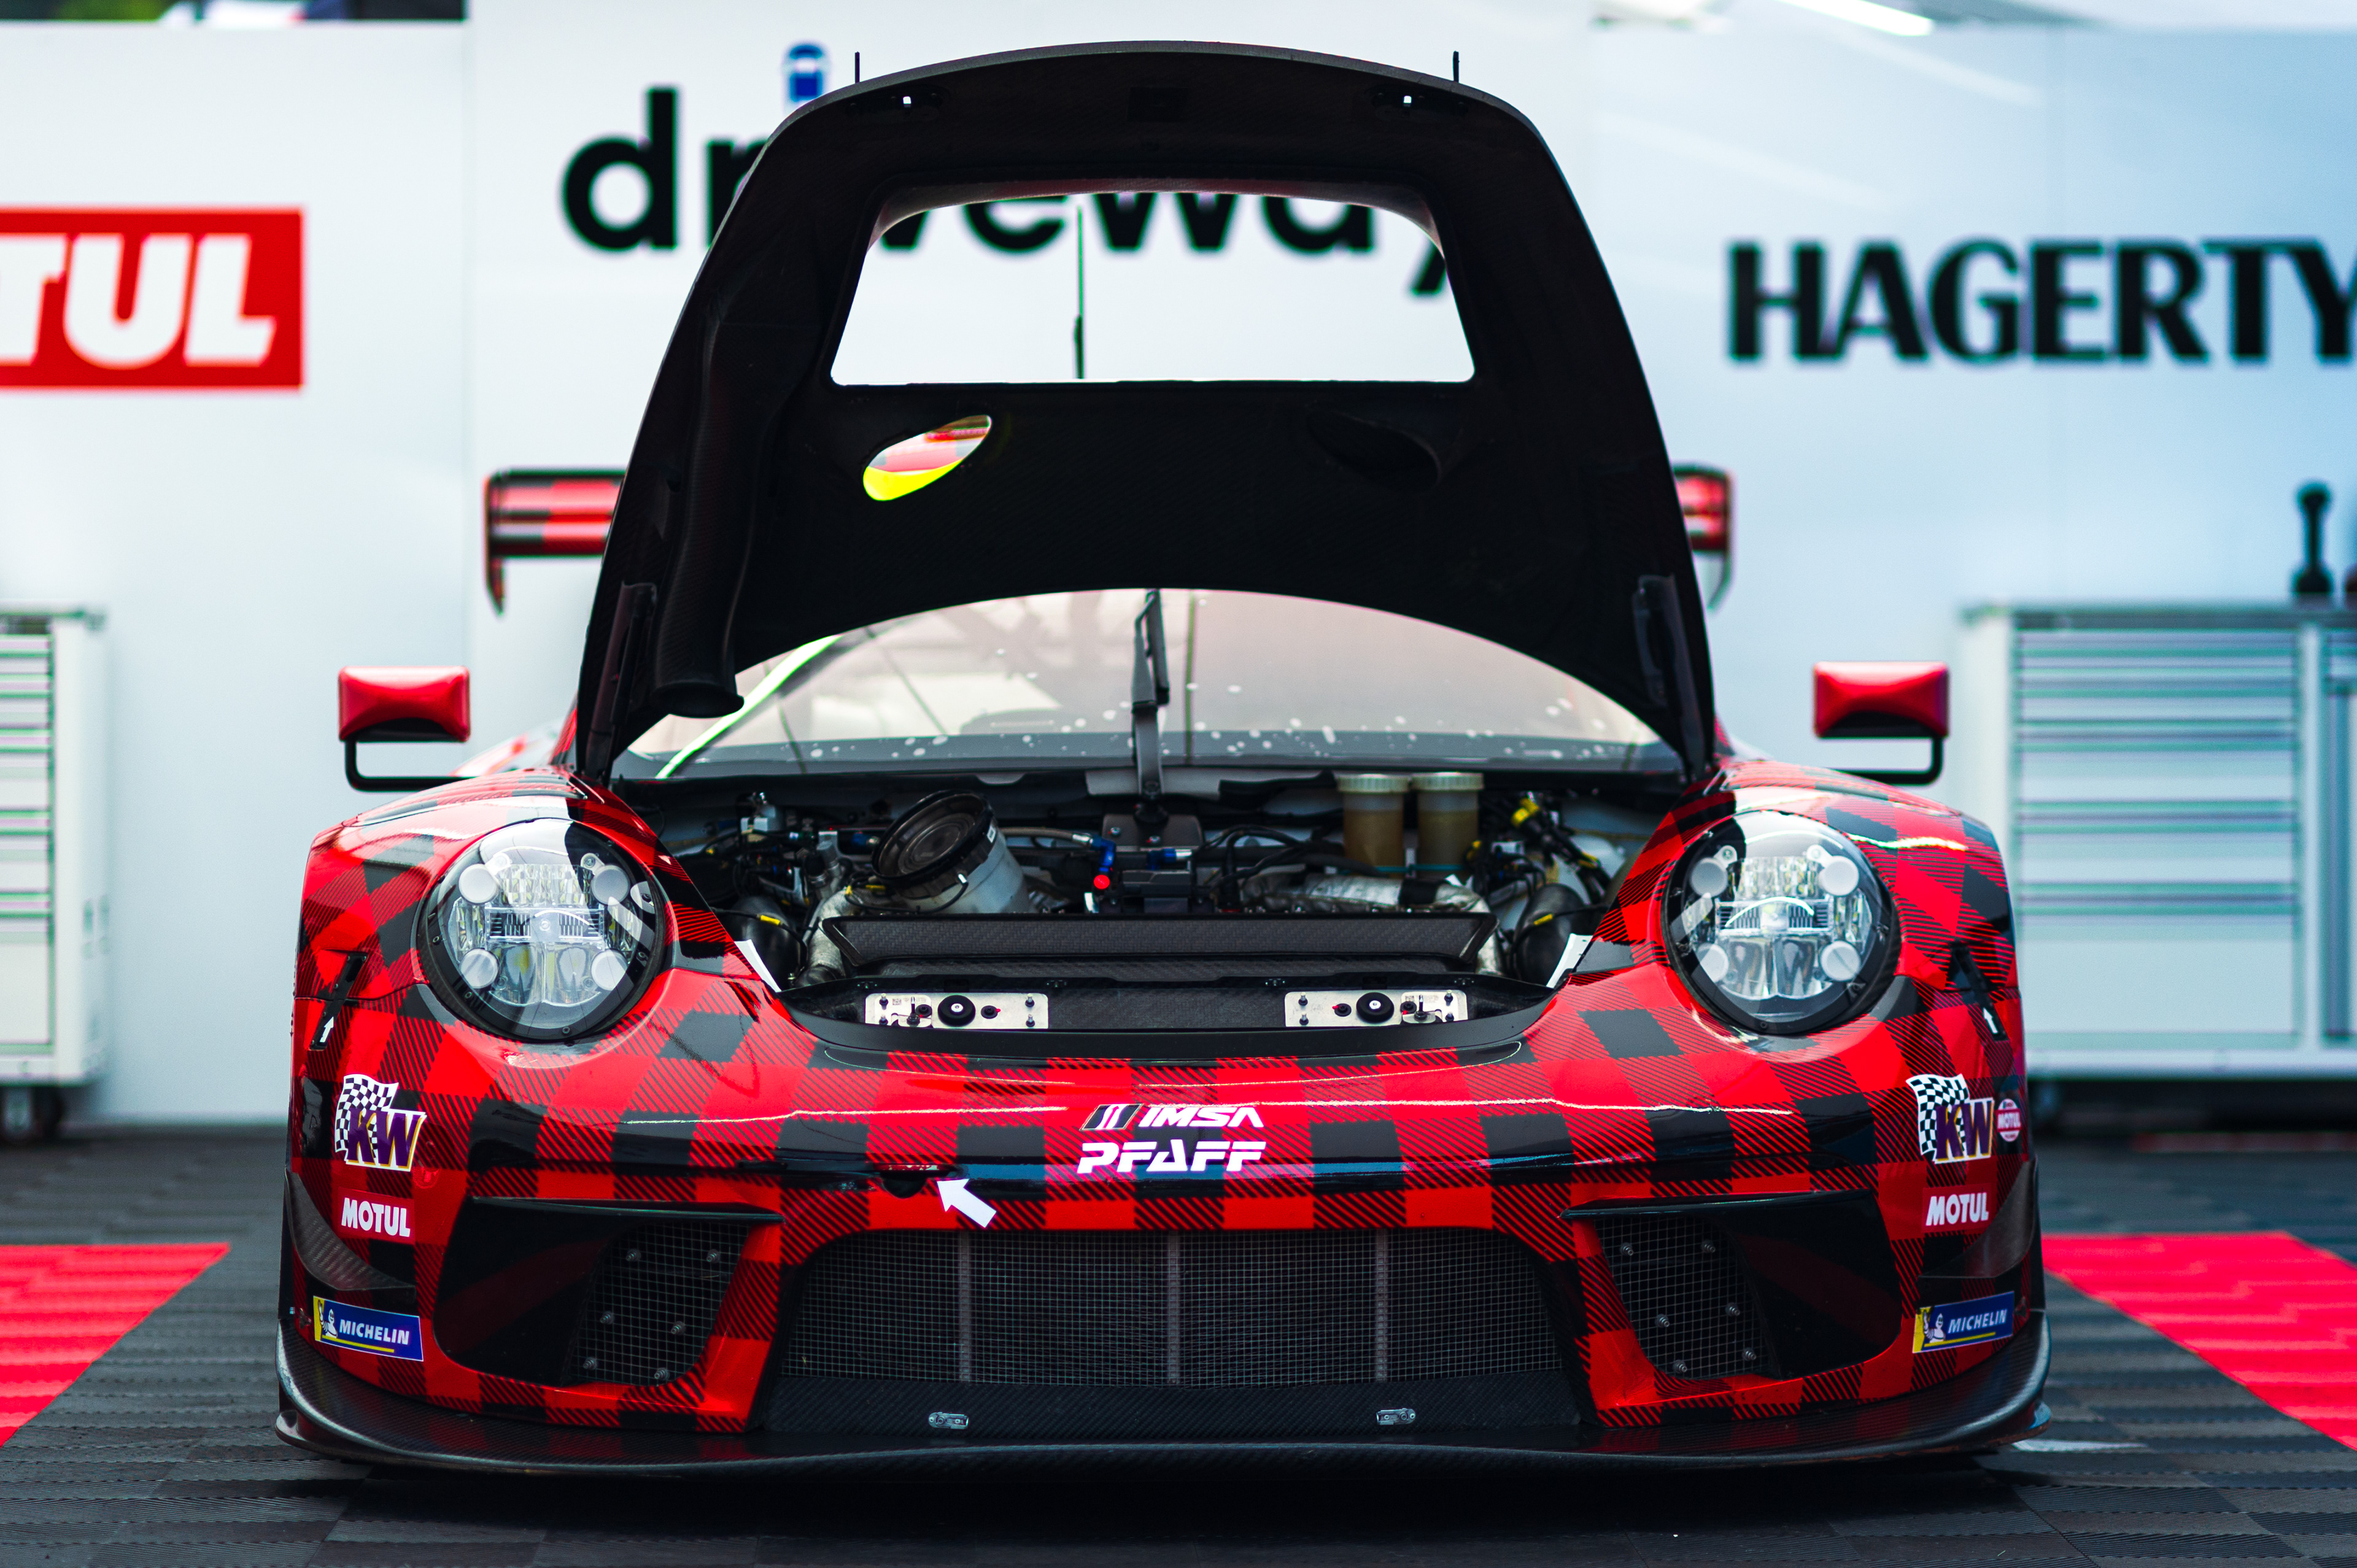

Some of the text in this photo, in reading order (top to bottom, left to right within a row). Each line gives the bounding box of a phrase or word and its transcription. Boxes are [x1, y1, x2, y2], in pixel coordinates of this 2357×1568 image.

[1727, 236, 2357, 366] HAGERTY
[1138, 1106, 1264, 1127] IMSA
[1935, 1100, 1994, 1161] KW
[348, 1108, 422, 1169] KW
[1077, 1139, 1266, 1173] PFAFF
[341, 1197, 411, 1237] MOTUL
[1925, 1192, 1989, 1226] MOTUL
[339, 1319, 410, 1345] MICHELIN
[1948, 1309, 2007, 1334] MICHELIN
